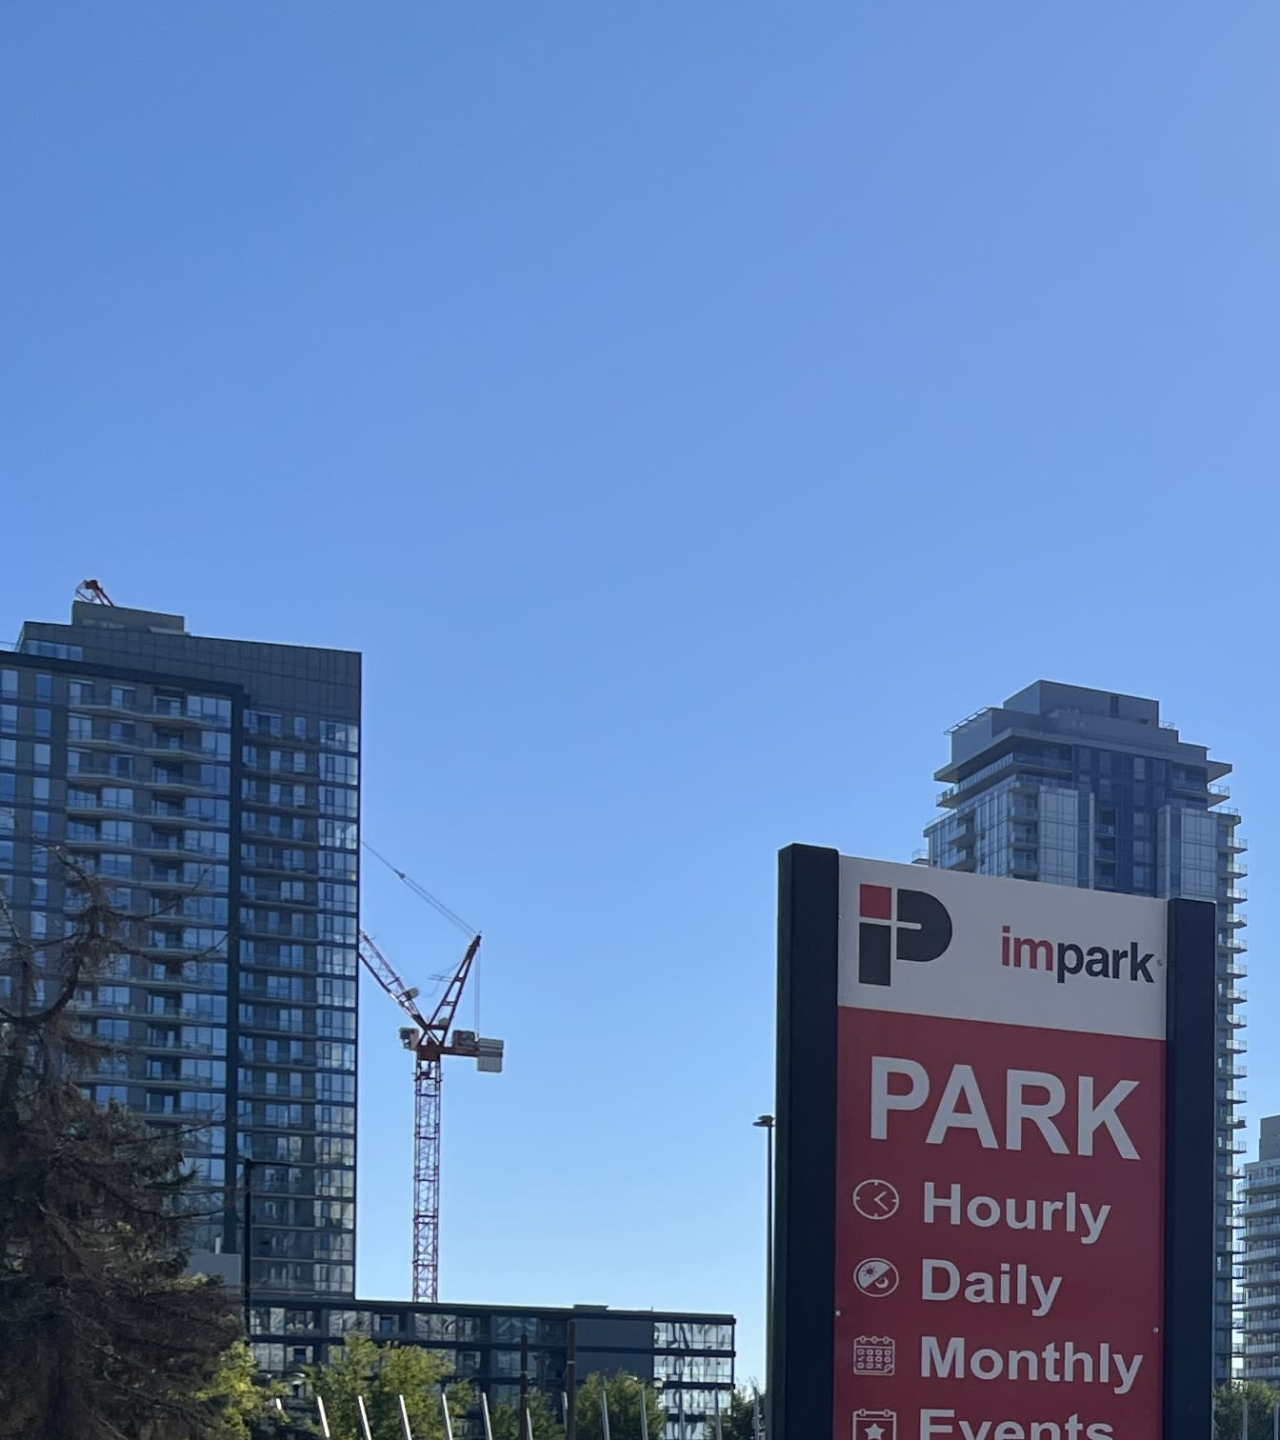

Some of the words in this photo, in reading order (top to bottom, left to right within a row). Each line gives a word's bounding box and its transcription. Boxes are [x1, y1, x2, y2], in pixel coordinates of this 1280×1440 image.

[1001, 925, 1155, 983] impark
[870, 1055, 1140, 1160] PARK
[923, 1182, 1111, 1244] Hourly
[921, 1259, 1062, 1316] Daily
[921, 1336, 1143, 1394] Monthly
